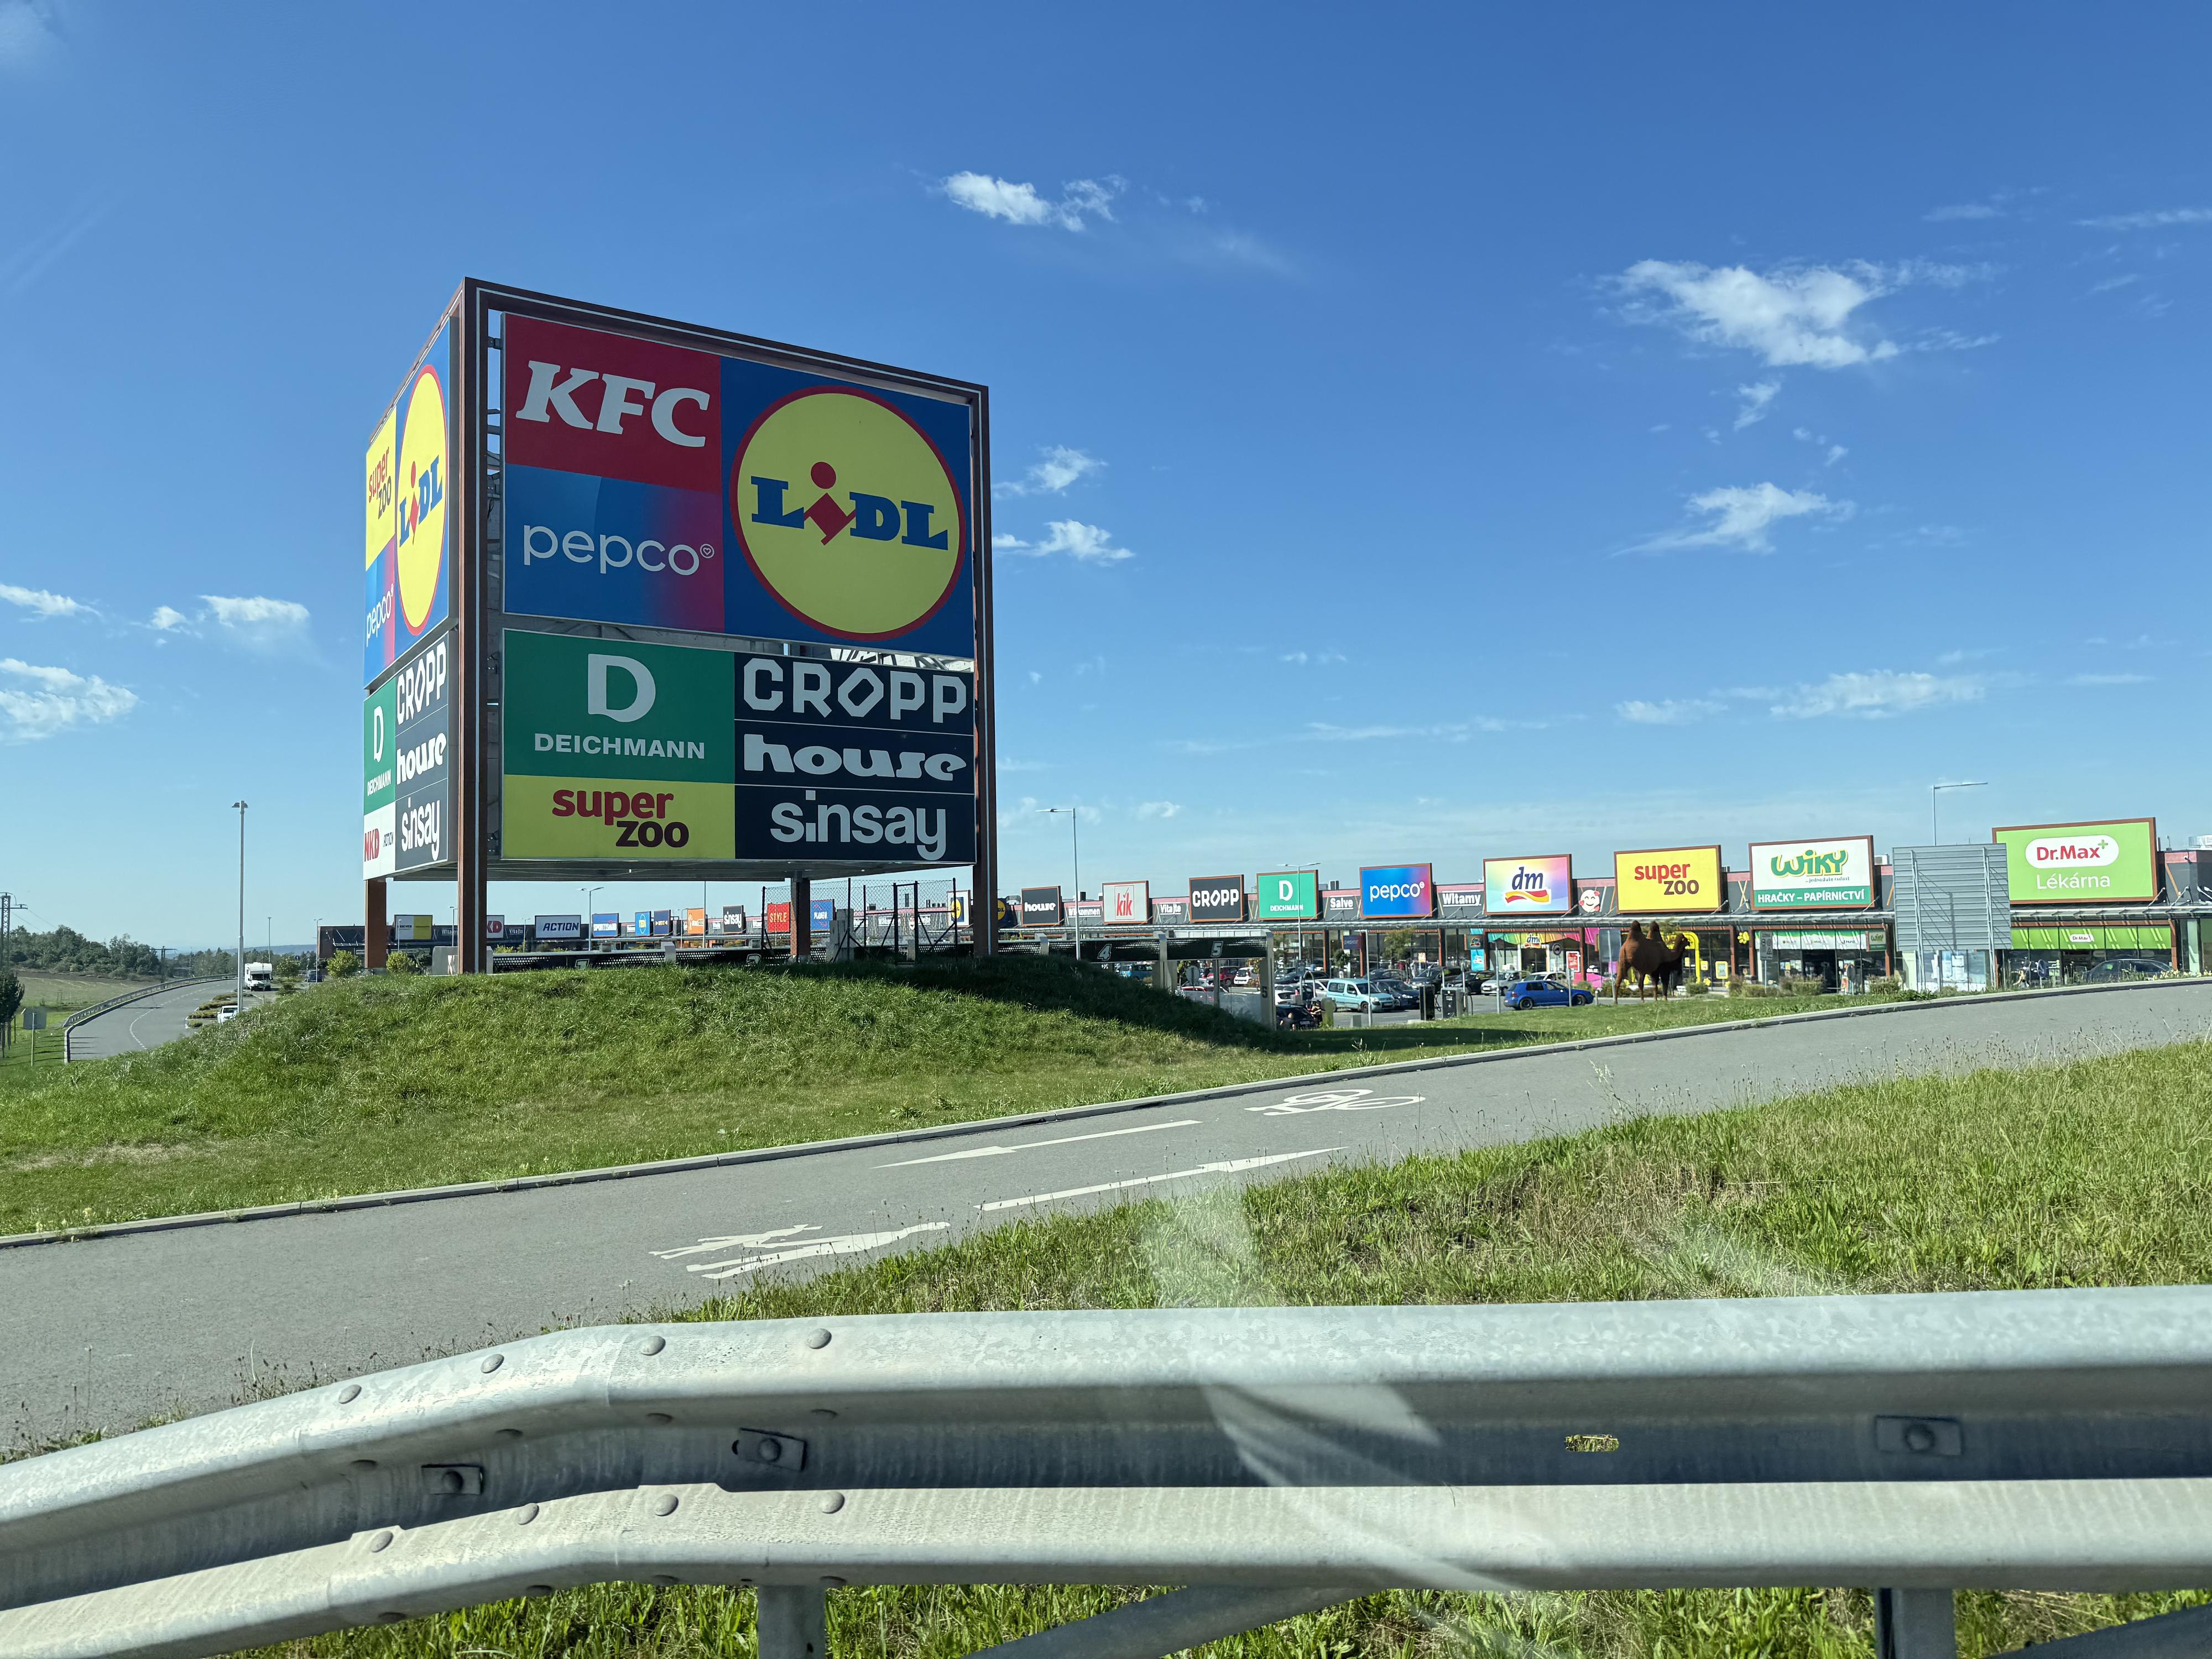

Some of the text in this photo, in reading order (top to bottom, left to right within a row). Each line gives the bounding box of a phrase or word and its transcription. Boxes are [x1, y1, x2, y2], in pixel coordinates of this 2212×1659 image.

[515, 360, 710, 448] KFC
[368, 446, 389, 504] super
[378, 476, 392, 520] zoo
[524, 524, 701, 575] pepco
[366, 589, 392, 647] pepco
[397, 640, 447, 726] CROPP
[587, 653, 656, 723] D
[743, 658, 967, 723] CROPP
[373, 705, 384, 763] D
[534, 733, 705, 759] DEICHMANN
[397, 732, 447, 785] house
[744, 733, 967, 781] house
[367, 769, 392, 797] DEICHMANN
[551, 789, 674, 826] super
[401, 797, 441, 862] sinsay
[616, 820, 690, 848] zoo
[770, 790, 947, 861] sinsay
[364, 828, 380, 862] NKD
[1511, 867, 1543, 891] dm
[1634, 863, 1691, 884] super
[2037, 872, 2110, 890] Lékárna
[1192, 889, 1239, 907] CROPP
[1279, 880, 1293, 901] D
[1370, 883, 1421, 902] pepco
[1443, 893, 1481, 906] Witamy
[1664, 880, 1699, 895] zoo
[1758, 891, 1796, 904] HRAČKY
[1804, 888, 1865, 902] PAPÍRNICTVÍ
[1024, 902, 1056, 912] house
[1117, 891, 1133, 916] kik
[1270, 904, 1304, 912] DEICHMANN
[1330, 898, 1353, 909] Salve
[487, 920, 503, 933] KD
[542, 922, 580, 932] ACTION
[723, 911, 742, 929] sinsay
[769, 912, 787, 923] STYLE
[1097, 943, 1112, 961] 4
[1211, 941, 1224, 958] 5
